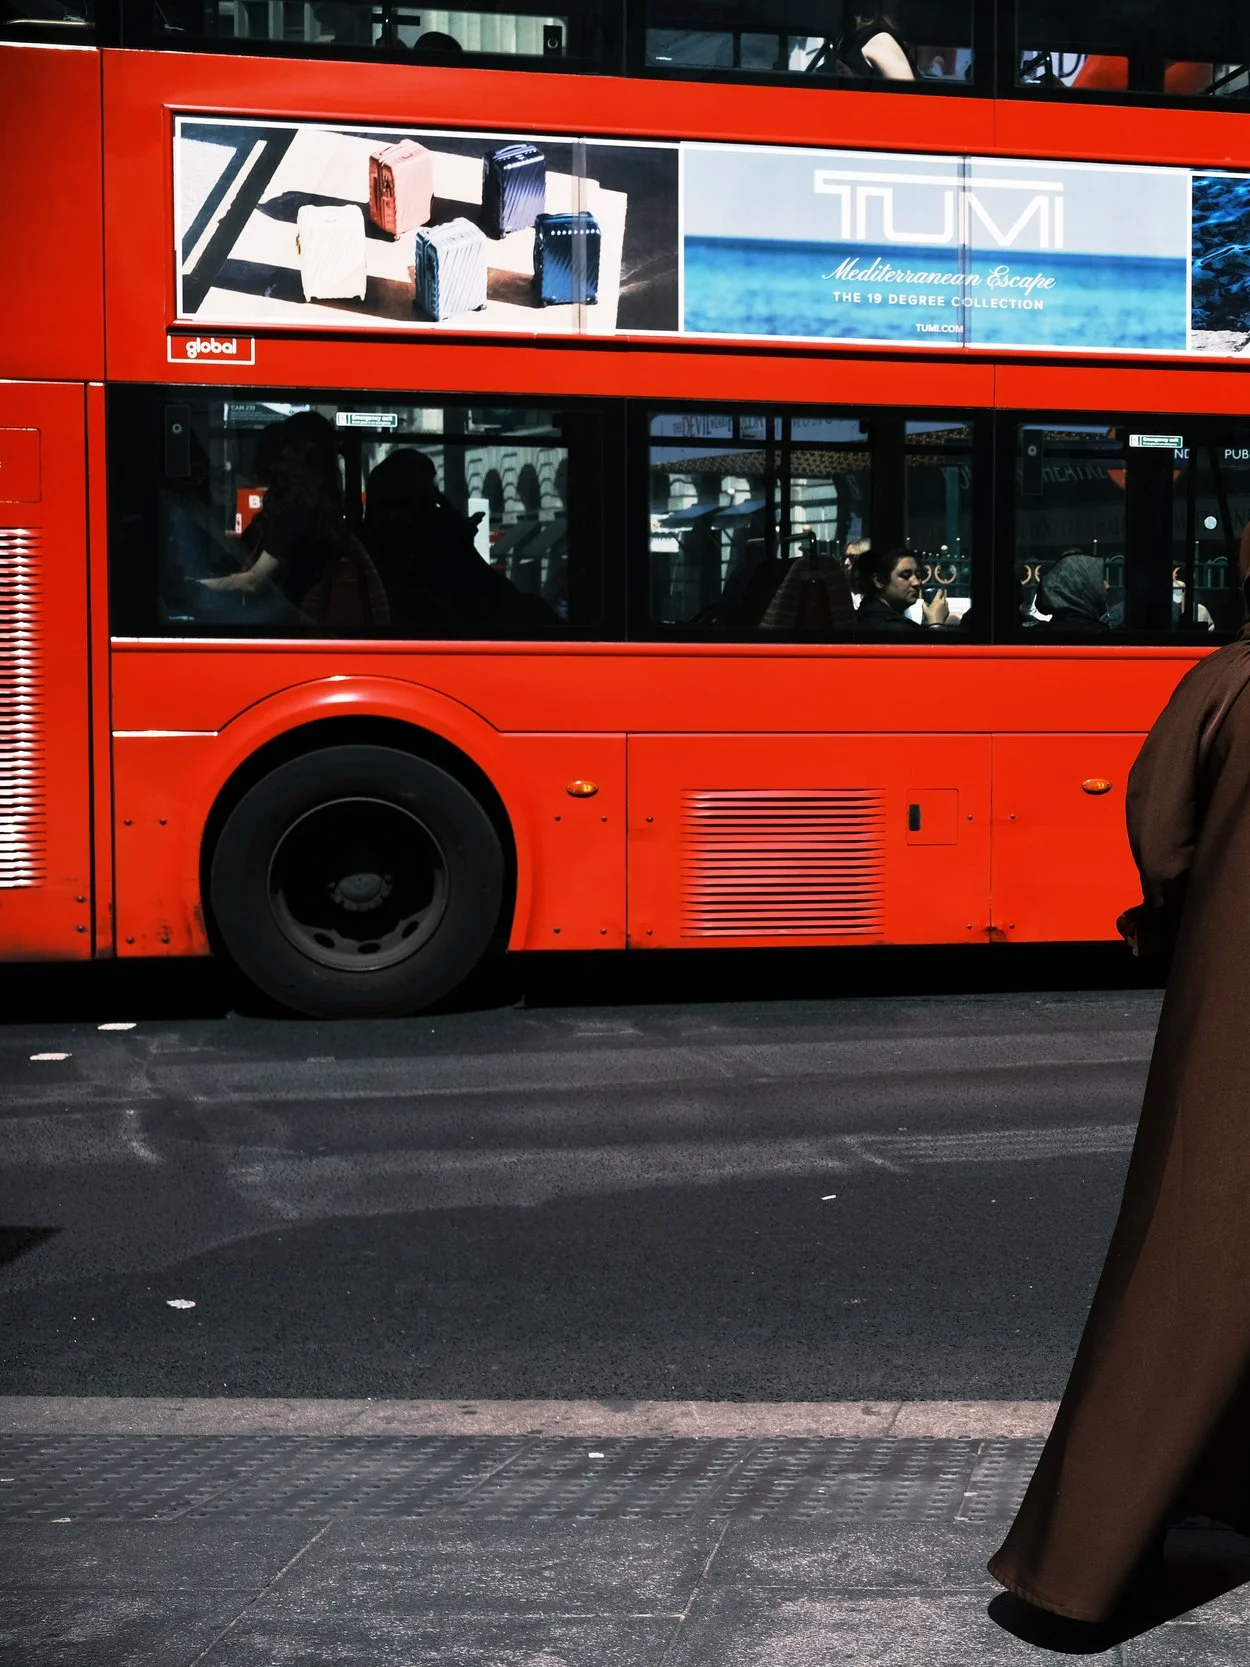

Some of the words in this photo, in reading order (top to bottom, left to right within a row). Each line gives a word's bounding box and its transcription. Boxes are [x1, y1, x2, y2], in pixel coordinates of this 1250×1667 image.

[814, 170, 1064, 249] TUMI
[821, 257, 982, 286] Mediterranean
[986, 265, 1056, 296] Escape
[833, 292, 861, 303] THE
[868, 294, 882, 304] 19
[889, 294, 945, 306] DEGREE
[951, 296, 1044, 310] COLLECTION
[915, 323, 964, 333] TUMI.COM
[185, 337, 237, 359] global
